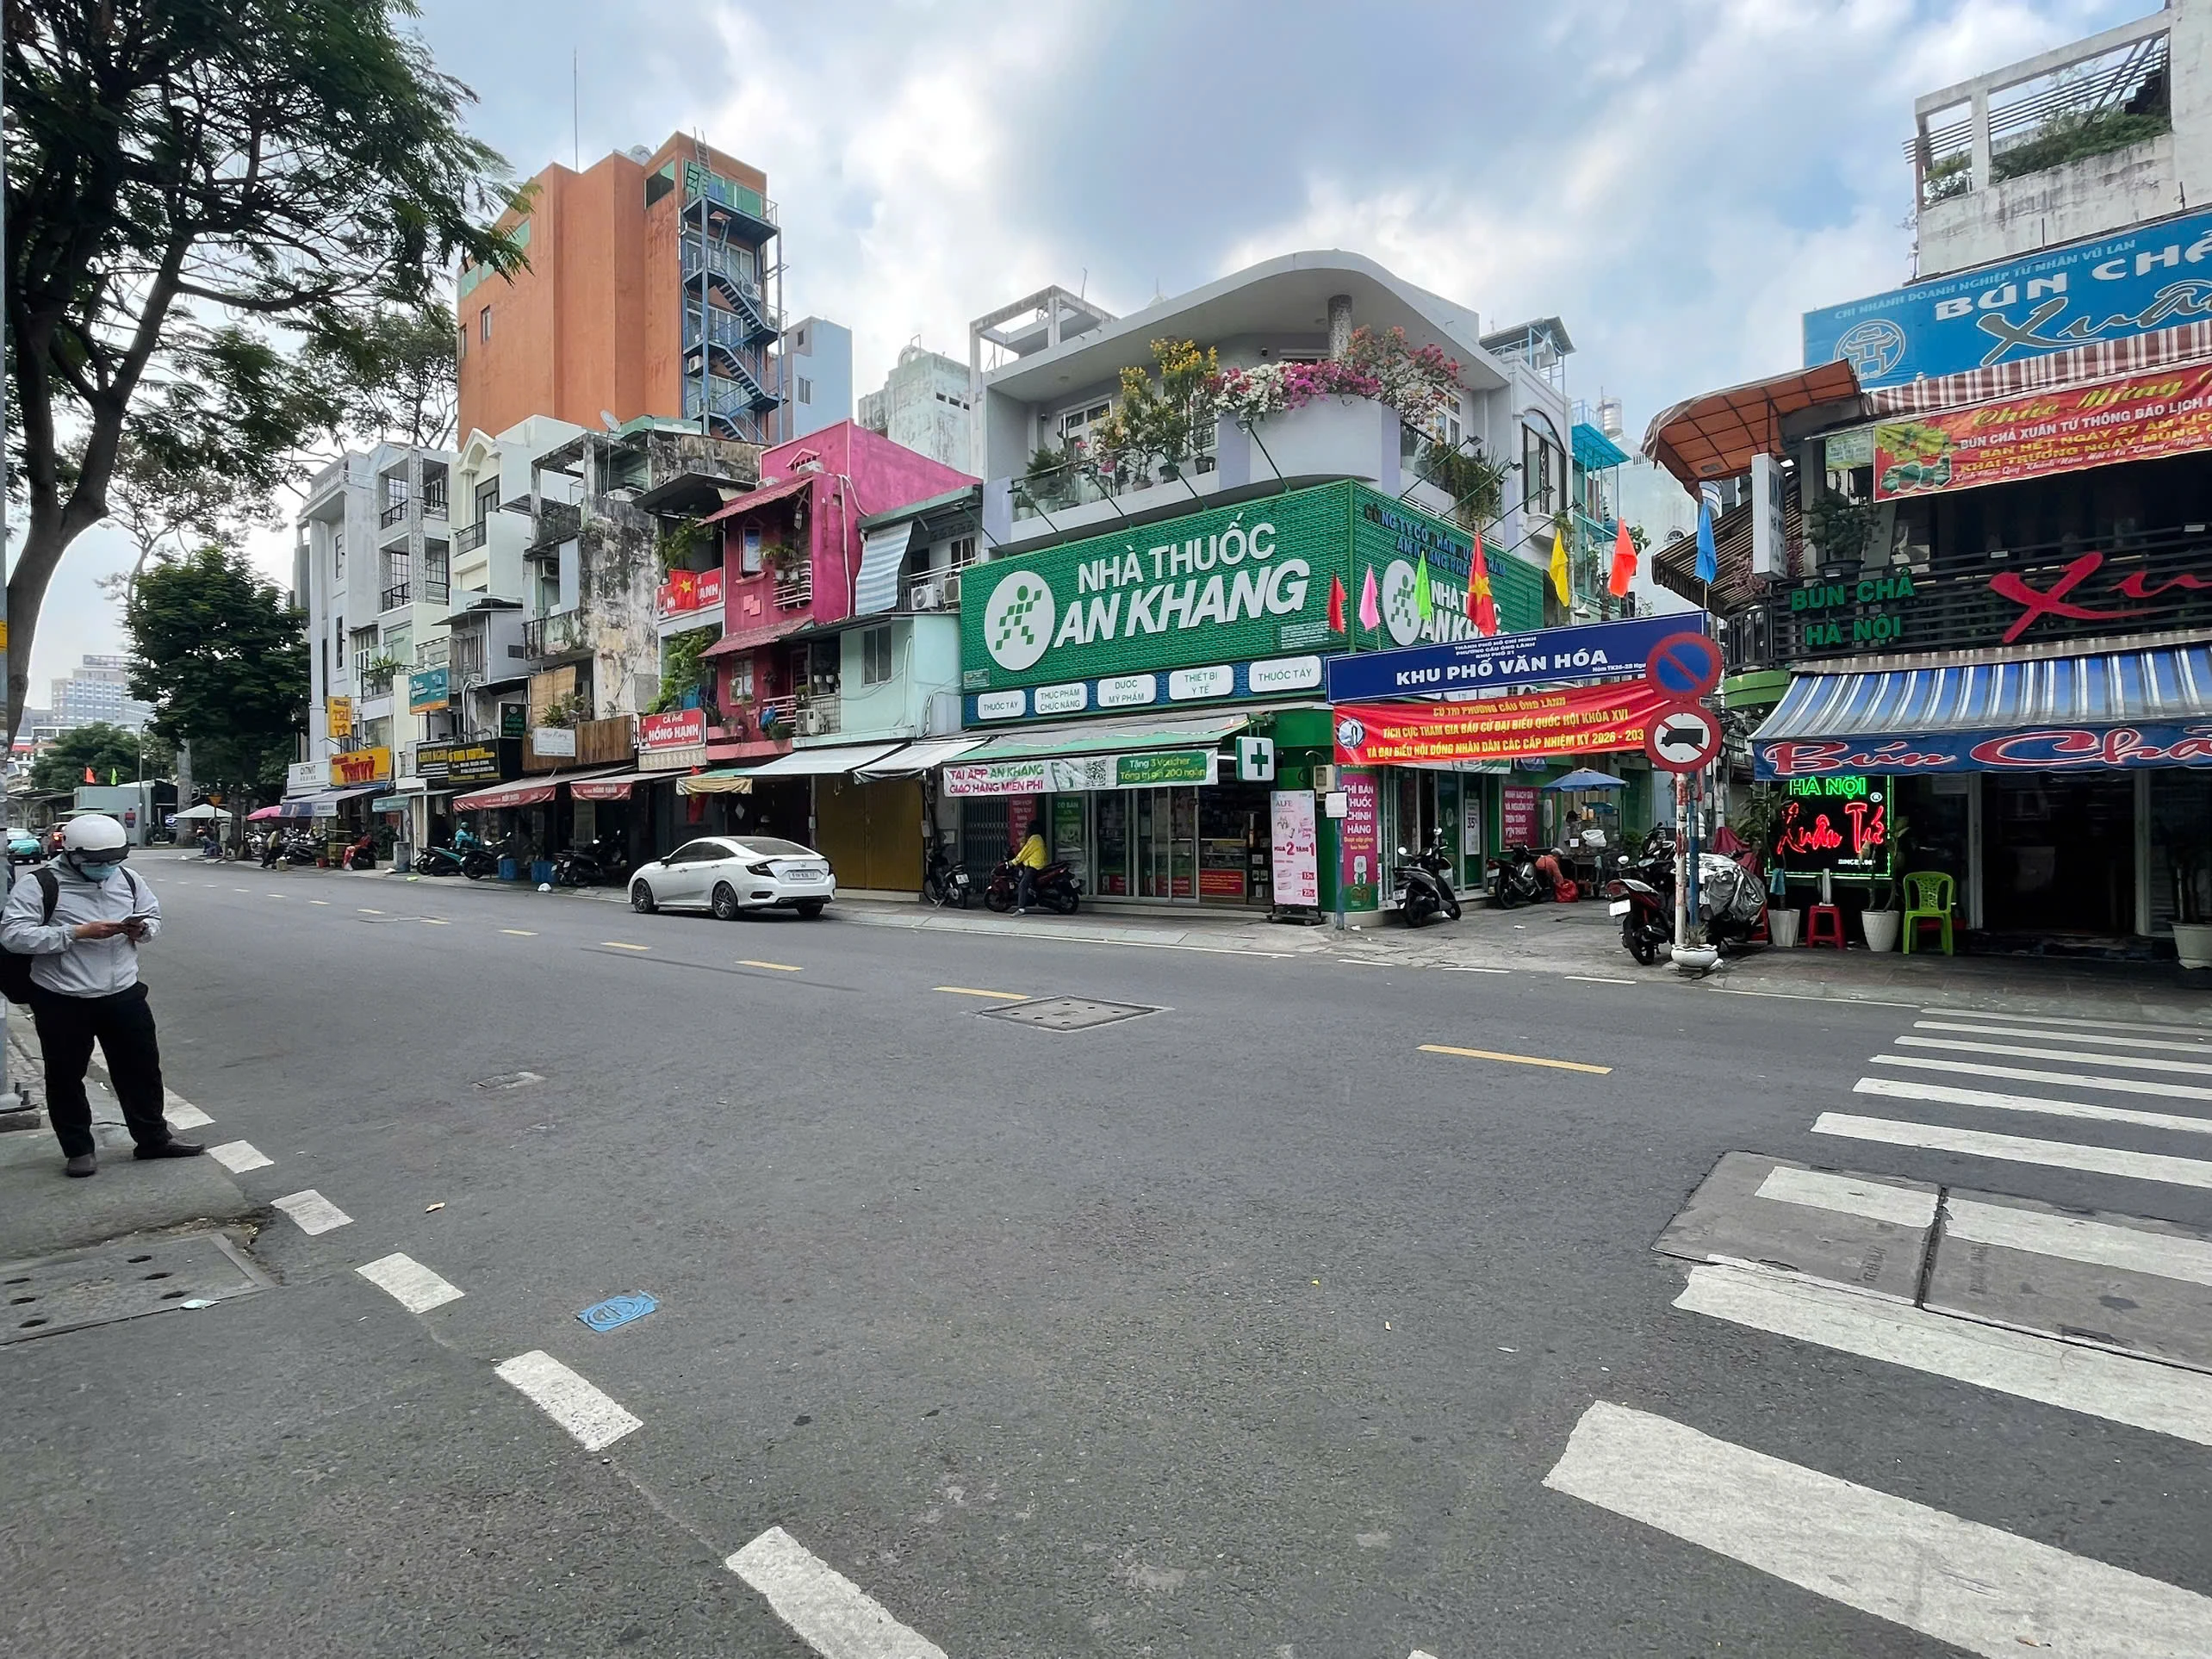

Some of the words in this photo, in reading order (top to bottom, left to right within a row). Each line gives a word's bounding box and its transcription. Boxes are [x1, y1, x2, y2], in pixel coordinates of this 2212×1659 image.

[1835, 308, 1855, 320] CHI
[1908, 284, 1955, 301] DOANH
[2035, 254, 2078, 270] NHÂN
[2106, 239, 2136, 254] LAN
[1934, 272, 2067, 321] BÚN
[1976, 278, 2212, 368] Xuâ
[1960, 436, 1987, 450] BÚN
[1990, 427, 2016, 444] CHẢ
[2020, 423, 2057, 440] XUÂN
[2081, 410, 2131, 429] THÔNG
[2134, 404, 2165, 420] BÁO
[2168, 397, 2203, 415] LỊCH
[2116, 425, 2140, 436] 27
[2180, 412, 2212, 426] LỊC
[1960, 459, 2002, 473] KHAI
[1399, 517, 1413, 537] TY
[1078, 544, 1144, 594] NHÀ
[1148, 513, 1277, 581] THUỐC
[1397, 535, 1412, 556] AN
[698, 583, 718, 600] ẠNH
[1431, 580, 1459, 612] NHÀ
[1791, 581, 1845, 612] BÚN
[1856, 568, 1916, 603] CHẢ
[1987, 550, 2212, 644] Xu
[1053, 592, 1122, 649] AN
[1125, 558, 1310, 637] KHANG
[1806, 618, 1842, 646] HÀ
[1854, 612, 1902, 644] NỘI
[1258, 669, 1291, 682] THUỐC
[1293, 668, 1312, 679] TÂY
[1396, 668, 1441, 686] KHU
[1446, 657, 1494, 680] PHỐ
[1499, 655, 1547, 674] VĂN
[1554, 648, 1608, 669] HÓA
[1115, 679, 1138, 690] DƯỢC
[1184, 671, 1208, 683] THIẾT
[1041, 691, 1059, 700] THỰC
[1059, 687, 1080, 699] PHẨM
[1109, 693, 1121, 704] MỸ
[1122, 692, 1145, 703] PHẨM
[1191, 686, 1197, 695] Y
[1198, 684, 1210, 694] TẾ
[984, 701, 1005, 711] THUỐC
[1006, 700, 1018, 710] TÂY
[1040, 701, 1059, 711] CHỨC
[1059, 699, 1080, 710] NĂNG
[648, 725, 674, 742] HỒNG
[674, 724, 699, 741] HẠNH
[1382, 725, 1401, 739] TÍCH
[1402, 725, 1419, 740] CỰC
[1420, 724, 1443, 736] THAM
[1444, 724, 1459, 736] GIA
[1461, 719, 1479, 735] BẦU
[1494, 720, 1510, 734] ĐẠI
[1512, 715, 1532, 730] BIỂU
[1534, 713, 1561, 729] QUỐC
[1563, 711, 1580, 728] HỘI
[1581, 709, 1610, 724] KHÓA
[1611, 708, 1629, 721] XVI
[1367, 746, 1377, 759] VÀ
[1378, 746, 1392, 759] ĐẠI
[1394, 743, 1413, 757] BIỂU
[1414, 743, 1428, 758] HỘI
[1430, 742, 1454, 755] ĐỒNG
[1456, 741, 1480, 754] NHÂN
[1482, 739, 1501, 753] DÂN
[1503, 735, 1521, 751] CÁC
[1522, 734, 1542, 750] CẤP
[1544, 732, 1575, 749] NHIỆM
[1576, 731, 1590, 746] KỲ
[1592, 730, 1616, 745] 2026
[1625, 729, 1644, 743] 203
[1129, 759, 1150, 771] Tặng
[1150, 758, 1157, 767] 3
[1157, 756, 1191, 767] Voucher
[1762, 740, 1958, 775] Bún
[966, 768, 988, 780] APP
[990, 767, 1005, 779] AN
[1006, 764, 1044, 778] KHANG
[1120, 769, 1140, 781] Tổng
[1165, 767, 1184, 778] 200
[949, 785, 972, 794] GIAO
[972, 782, 1000, 793] HÀNG
[1358, 782, 1374, 794] BÁN
[1789, 775, 1822, 796] HÀ
[1825, 775, 1867, 800] NỘI
[1347, 823, 1371, 835] HÃNG
[1286, 841, 1295, 856] 2
[1309, 842, 1315, 856] 1
